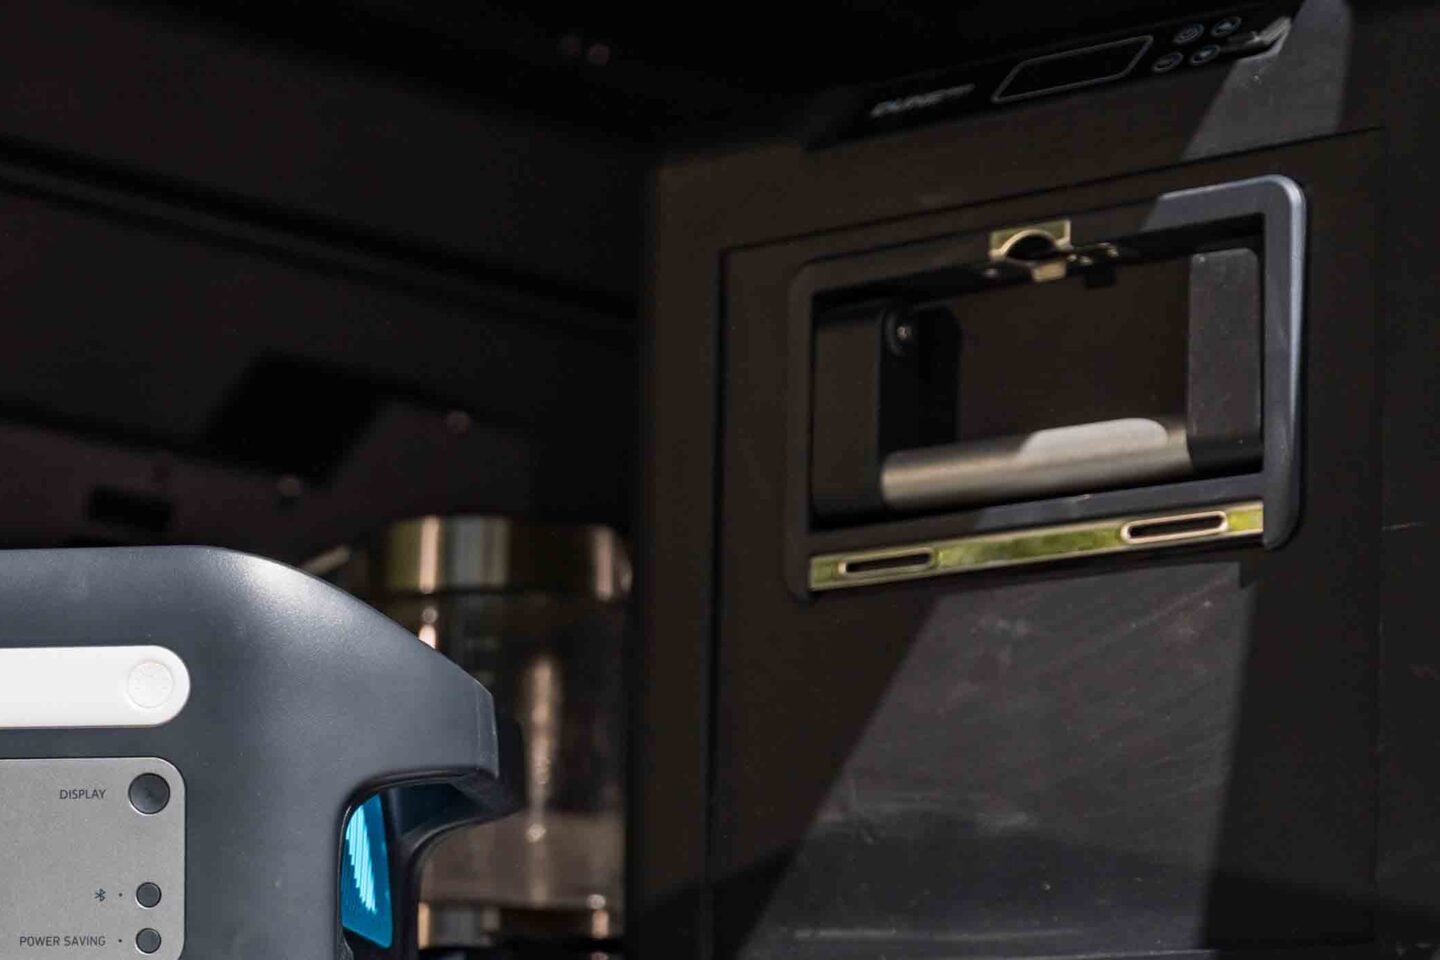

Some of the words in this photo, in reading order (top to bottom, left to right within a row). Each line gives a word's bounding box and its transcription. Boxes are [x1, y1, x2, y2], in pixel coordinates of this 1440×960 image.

[59, 788, 107, 800] DISPLAY
[19, 935, 61, 947] POWER
[63, 935, 107, 947] SAVING
